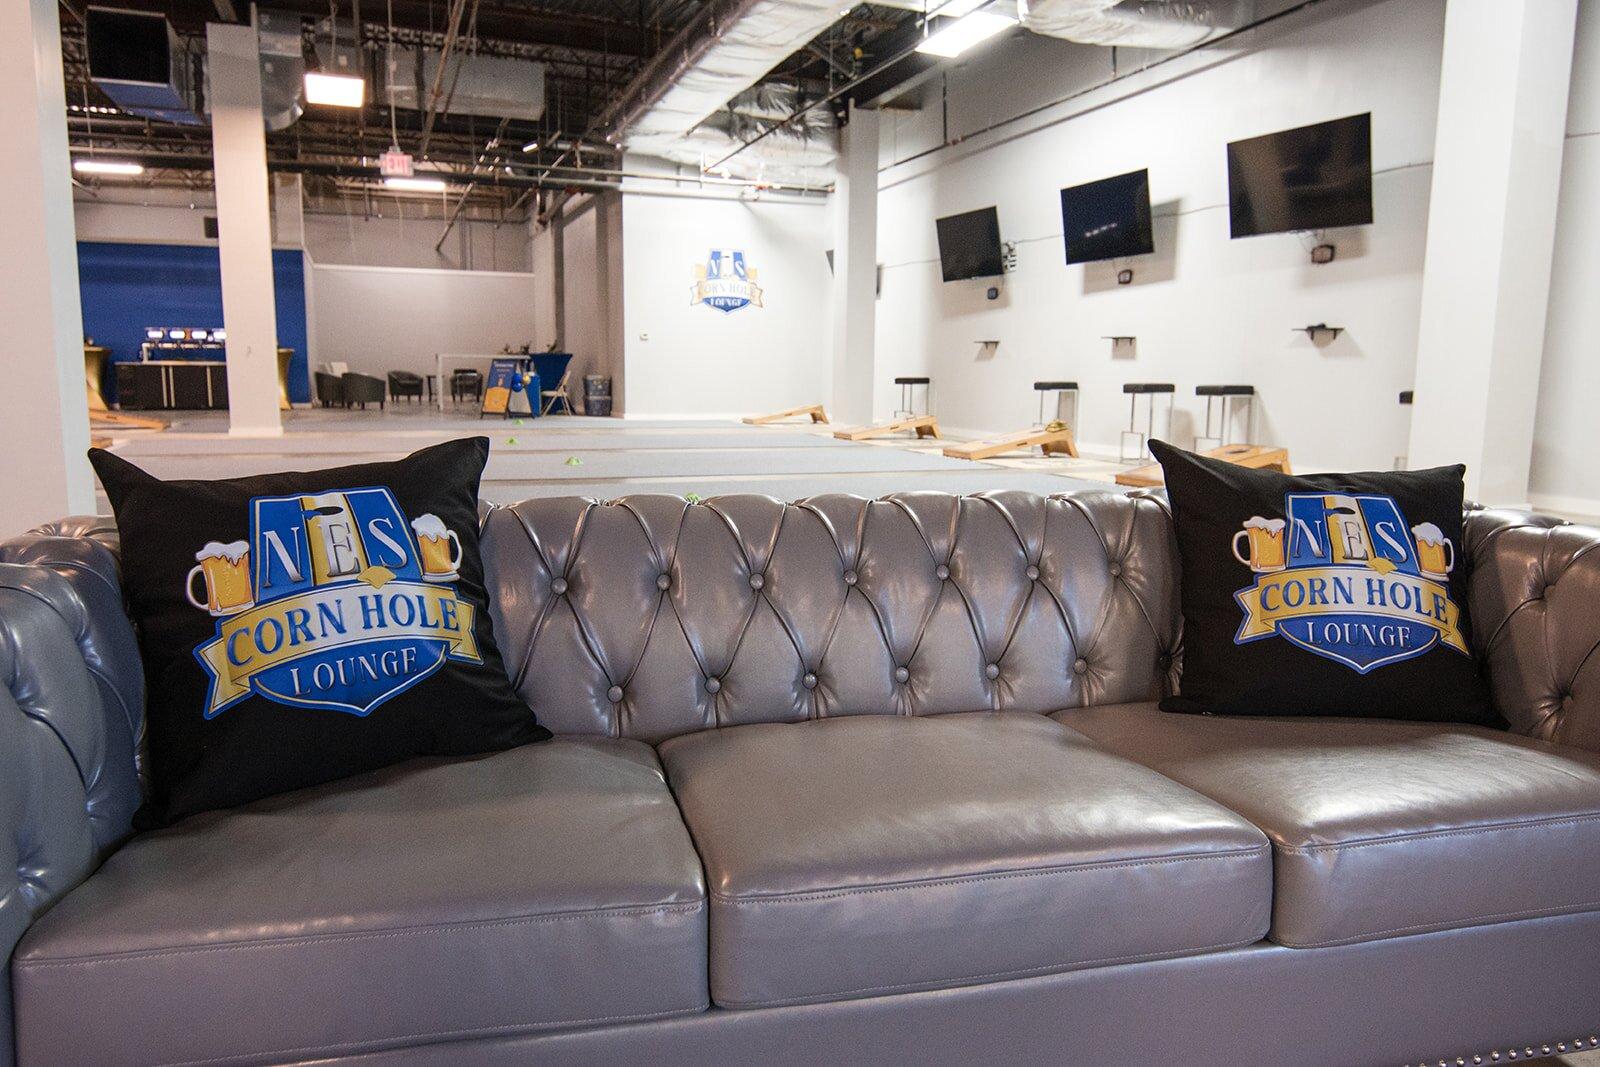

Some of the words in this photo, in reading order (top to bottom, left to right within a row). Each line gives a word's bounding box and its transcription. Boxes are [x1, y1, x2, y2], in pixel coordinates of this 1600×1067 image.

[698, 282, 726, 297] ORN
[709, 259, 746, 277] NS
[710, 298, 742, 306] LOUNGE
[262, 517, 409, 588] NES
[1293, 518, 1408, 563] NES
[1259, 576, 1354, 612] CORN
[1366, 578, 1448, 624] HOLE
[226, 599, 347, 667] CORN
[358, 593, 461, 632] HOLE
[1306, 621, 1411, 649] LOUNGE
[290, 647, 417, 696] LOUNGE
